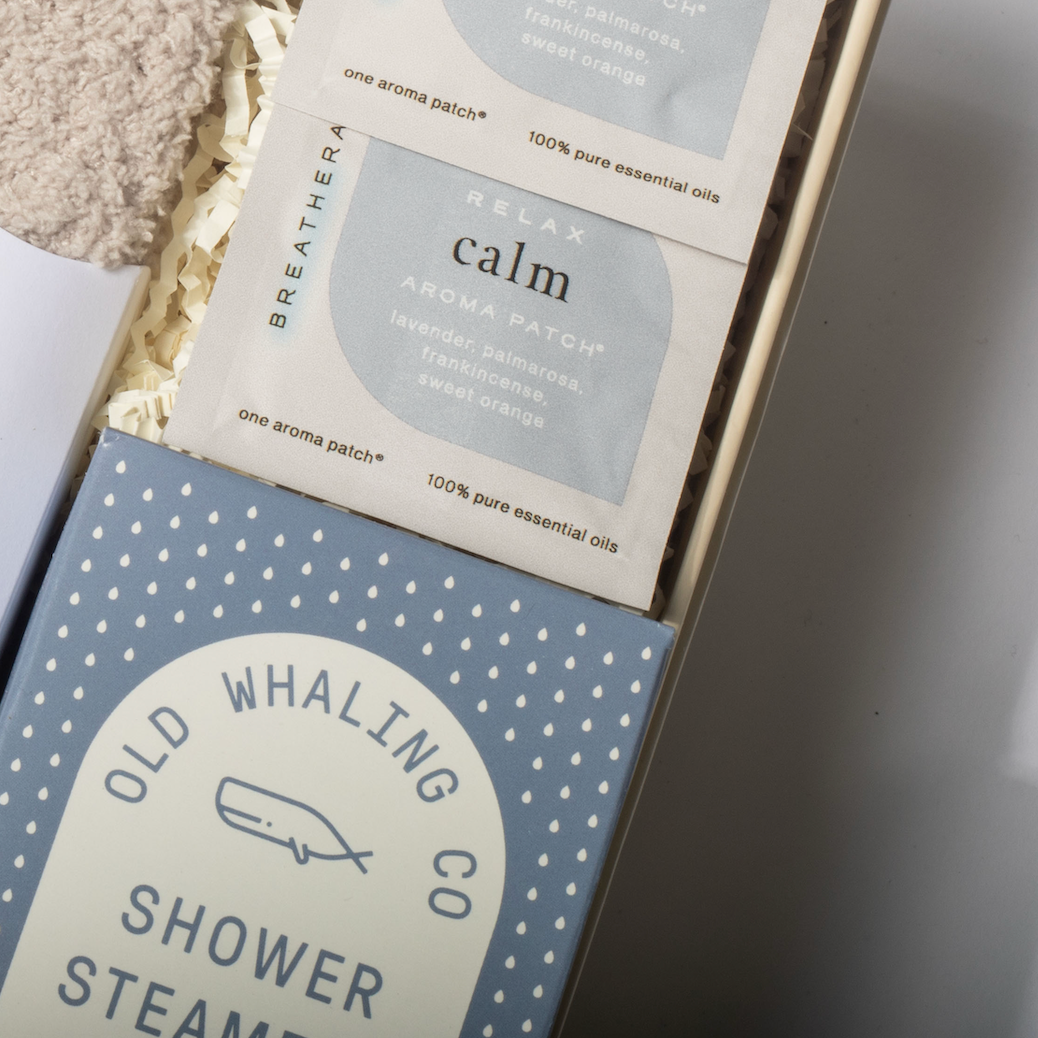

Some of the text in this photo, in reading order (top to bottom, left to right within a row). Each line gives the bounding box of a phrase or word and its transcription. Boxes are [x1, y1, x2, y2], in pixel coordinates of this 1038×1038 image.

[521, 31, 646, 87] sweet orange
[524, 6, 649, 65] frankincense,
[584, 4, 685, 54] palmarosa,
[343, 67, 374, 85] one
[378, 77, 428, 104] aroma
[527, 130, 721, 204] 100% pure essential oils
[466, 190, 585, 245] RELAX
[400, 276, 496, 320] AROMA
[452, 237, 570, 304] calm
[390, 309, 584, 396] lavender, palmarosa,
[421, 346, 548, 407] frankincense,
[238, 408, 269, 427] one
[272, 418, 324, 447] aroma
[418, 373, 545, 429] sweet orange
[426, 472, 619, 554] 100% pure essential oils
[103, 663, 478, 921] OLD WHALING CO
[121, 883, 384, 1020] SHOWER
[57, 955, 310, 1038] STEA
